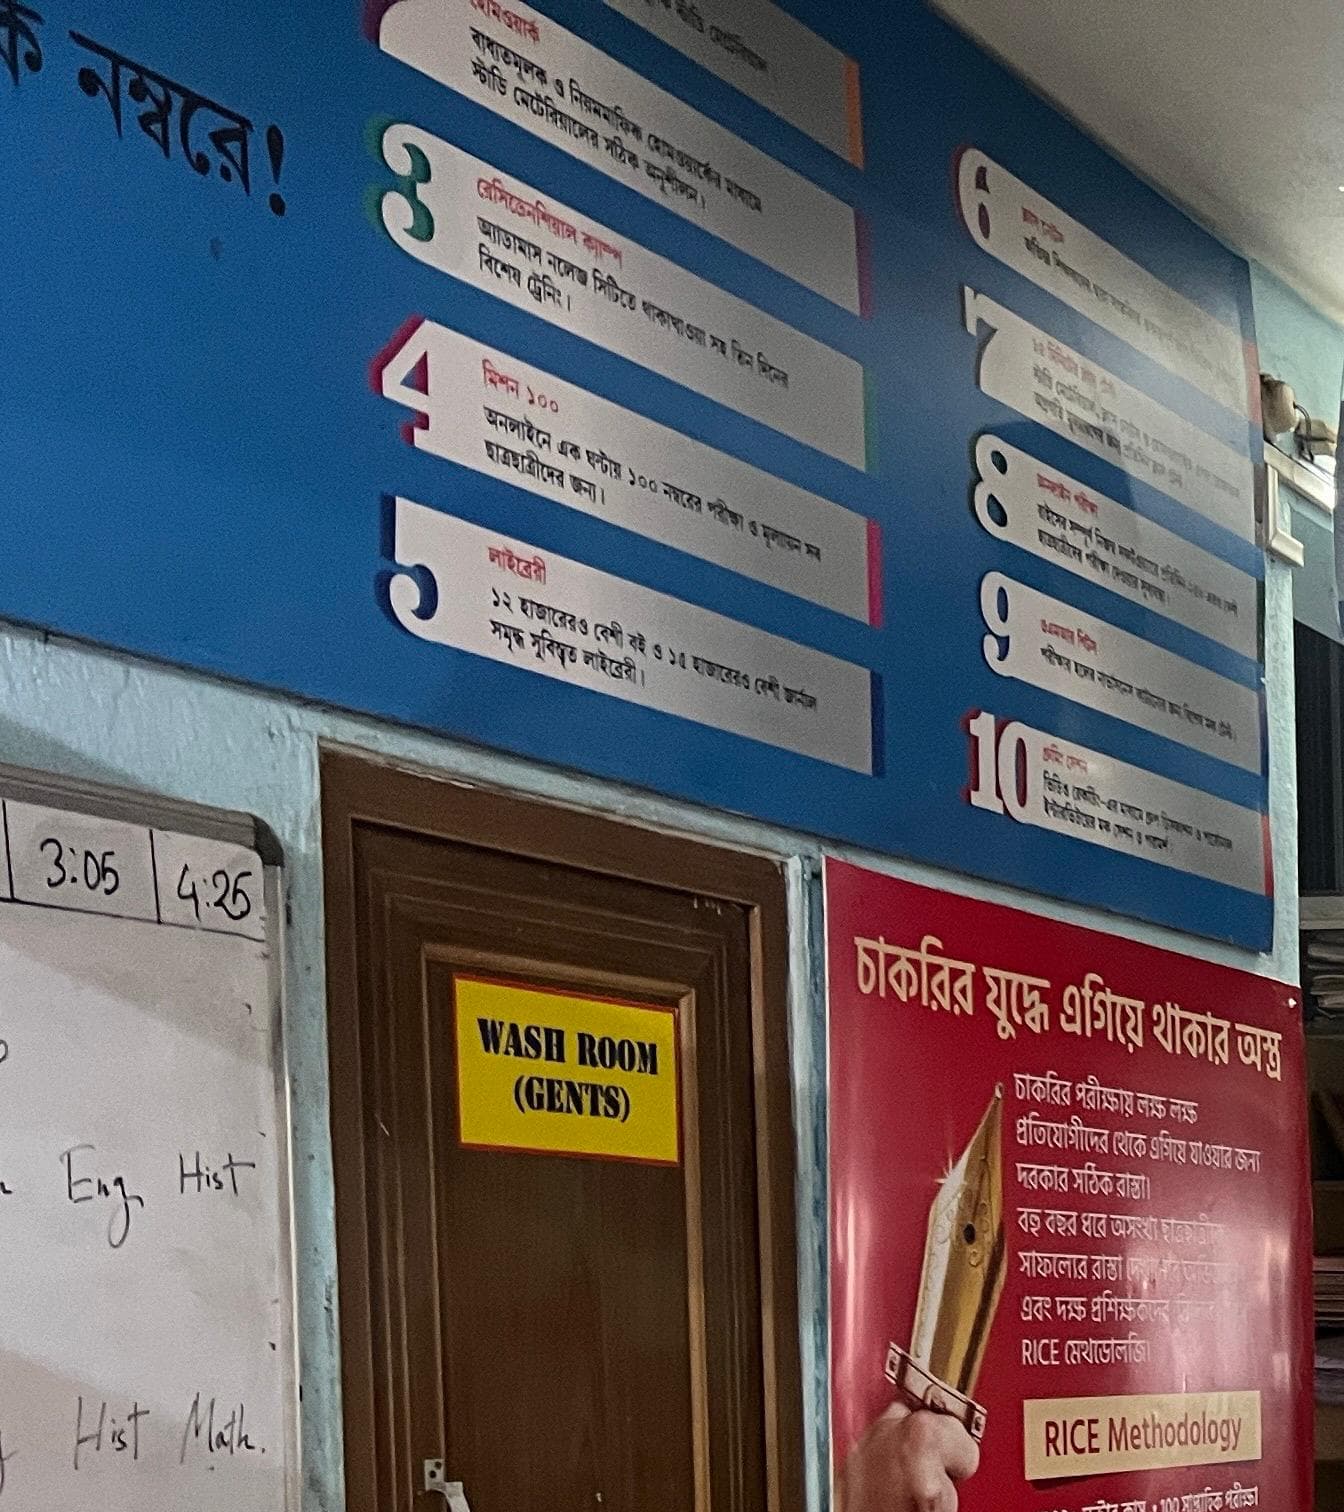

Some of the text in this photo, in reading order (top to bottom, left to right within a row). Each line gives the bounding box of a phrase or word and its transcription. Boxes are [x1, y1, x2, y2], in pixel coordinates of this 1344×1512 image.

[68, 30, 286, 217] নম্বরে!
[380, 123, 437, 264] 3
[958, 147, 1000, 256] 6
[378, 318, 431, 447] 4
[482, 358, 559, 414] মিশন ১০০
[974, 433, 1011, 541] 8
[388, 496, 438, 638] 5
[980, 571, 1011, 676] 9
[962, 709, 1032, 824] 10
[39, 835, 252, 922] 3:05 4:25
[477, 1017, 660, 1078] WASH ROOM
[853, 935, 1282, 1082] চাকরির যুদ্ধে এগিয়ে থাকার অস্ত্র
[512, 1073, 631, 1123] (GENTS)
[1013, 1070, 1072, 1106] চাকরির
[178, 1151, 256, 1198] Hist
[1022, 1338, 1060, 1366] RICE
[74, 1395, 151, 1471] Hist
[1044, 1415, 1242, 1458] RICE Methodology
